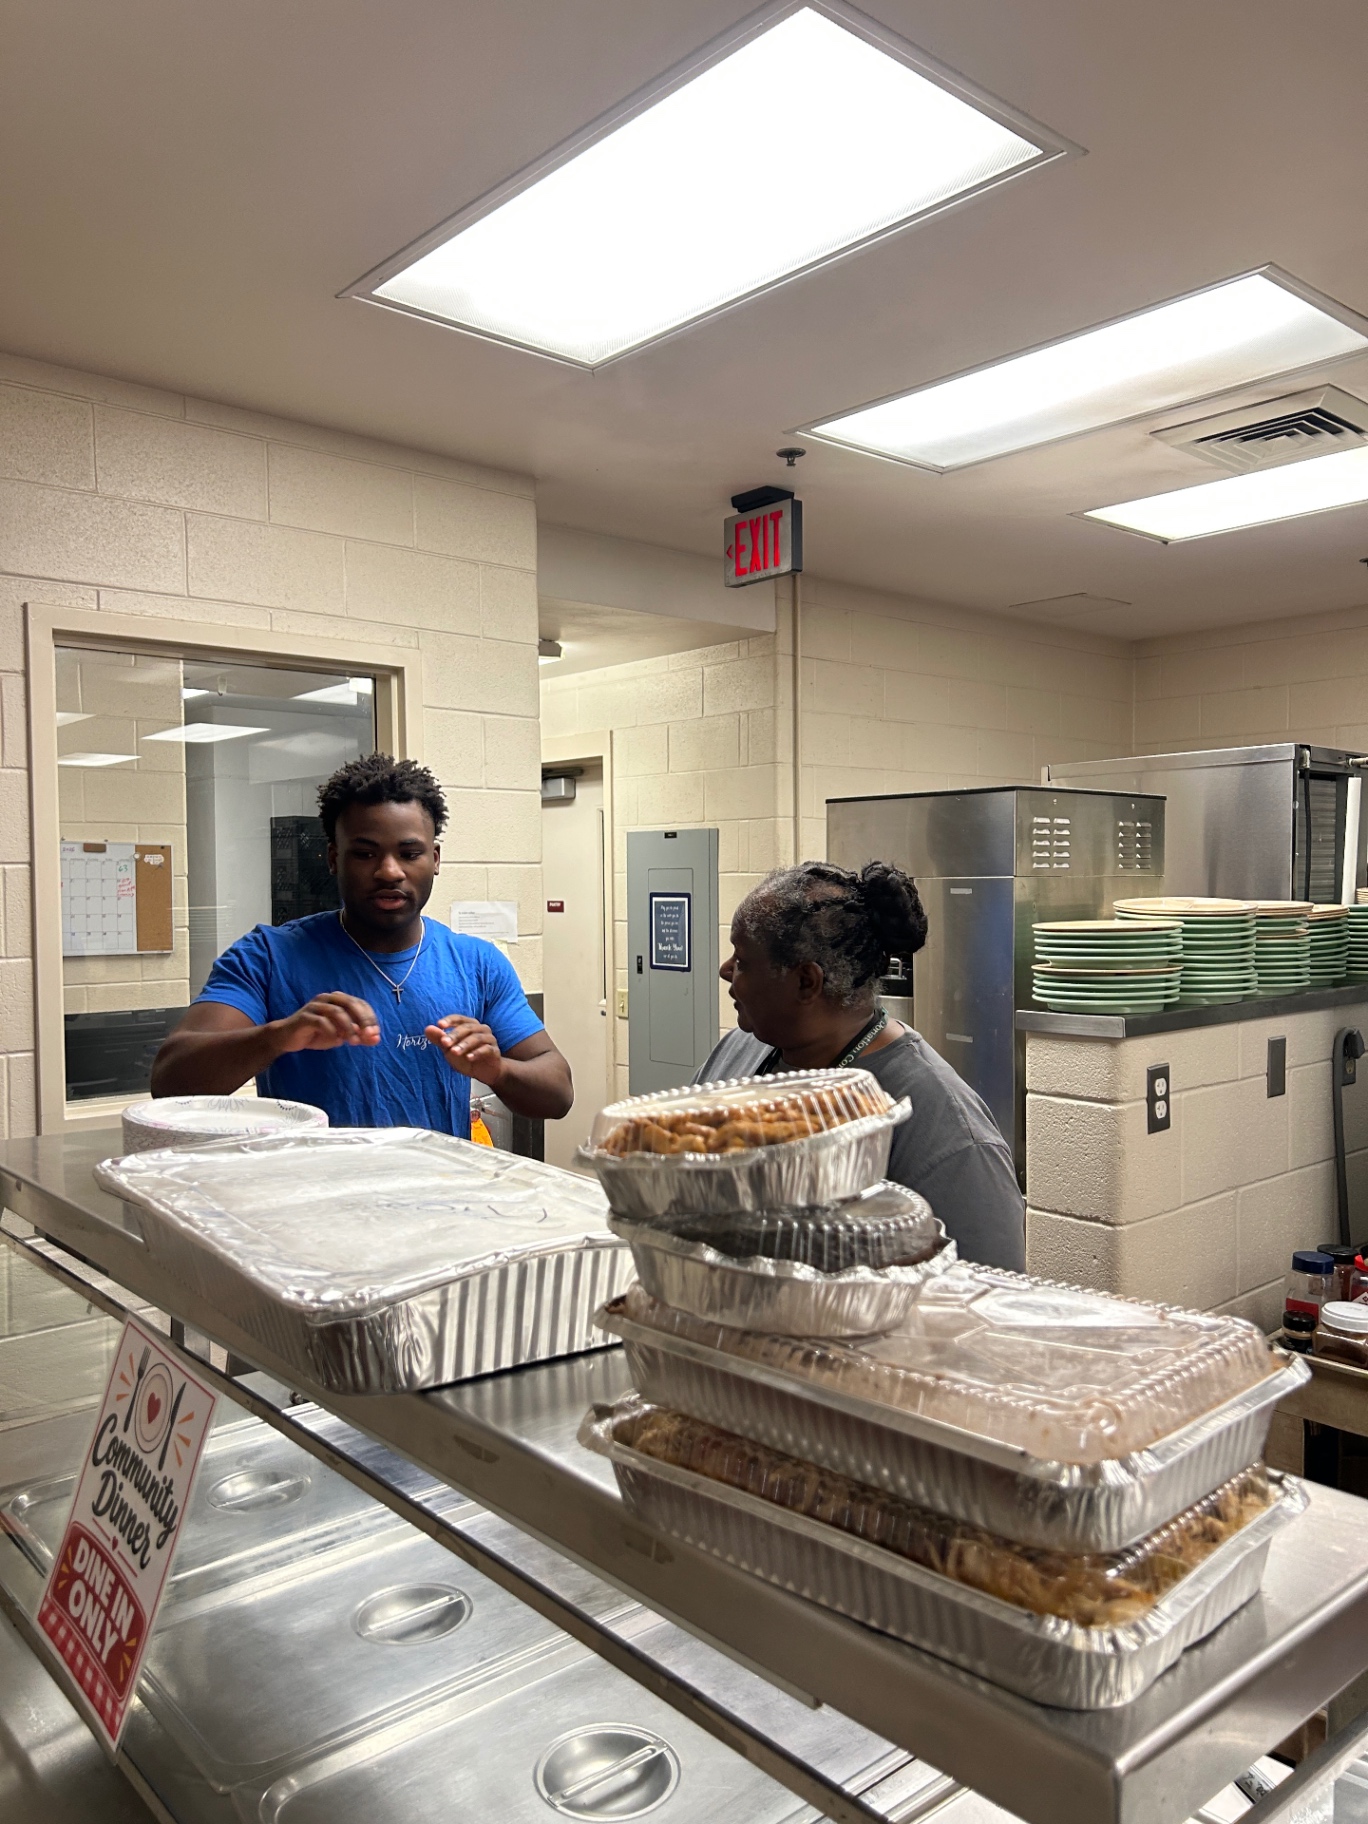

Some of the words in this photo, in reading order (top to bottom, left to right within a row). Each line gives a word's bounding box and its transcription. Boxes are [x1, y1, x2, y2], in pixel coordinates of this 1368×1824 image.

[735, 510, 783, 577] EXIT
[92, 1412, 178, 1550] Community
[92, 1469, 151, 1570] Dinner
[68, 1579, 119, 1664] ONLY
[73, 1538, 116, 1608] DINE
[110, 1584, 135, 1642] IN
